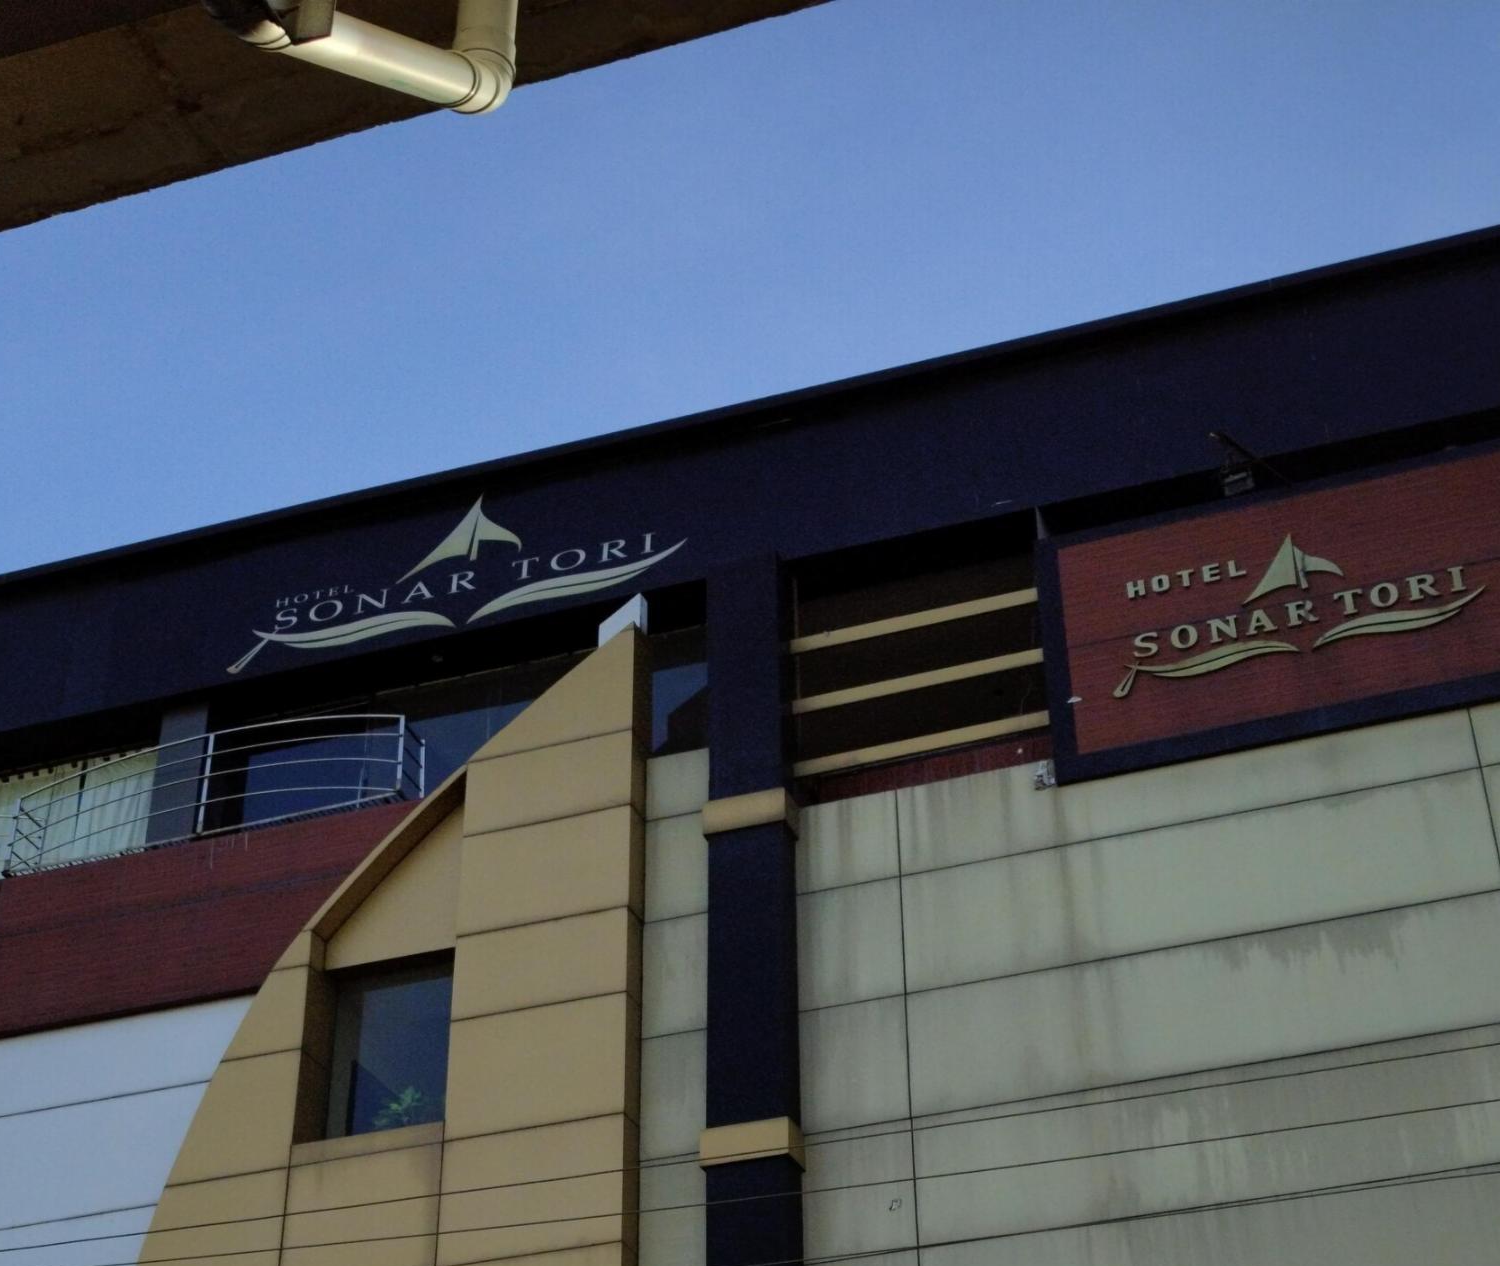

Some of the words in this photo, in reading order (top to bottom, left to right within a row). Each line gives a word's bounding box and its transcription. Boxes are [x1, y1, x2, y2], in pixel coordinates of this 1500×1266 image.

[275, 570, 476, 630] SONAR
[512, 532, 657, 581] TORI
[276, 585, 355, 608] HOTEL
[1126, 560, 1248, 599] HOTEL
[1133, 599, 1319, 658] SONAR
[1334, 566, 1468, 616] TORI
